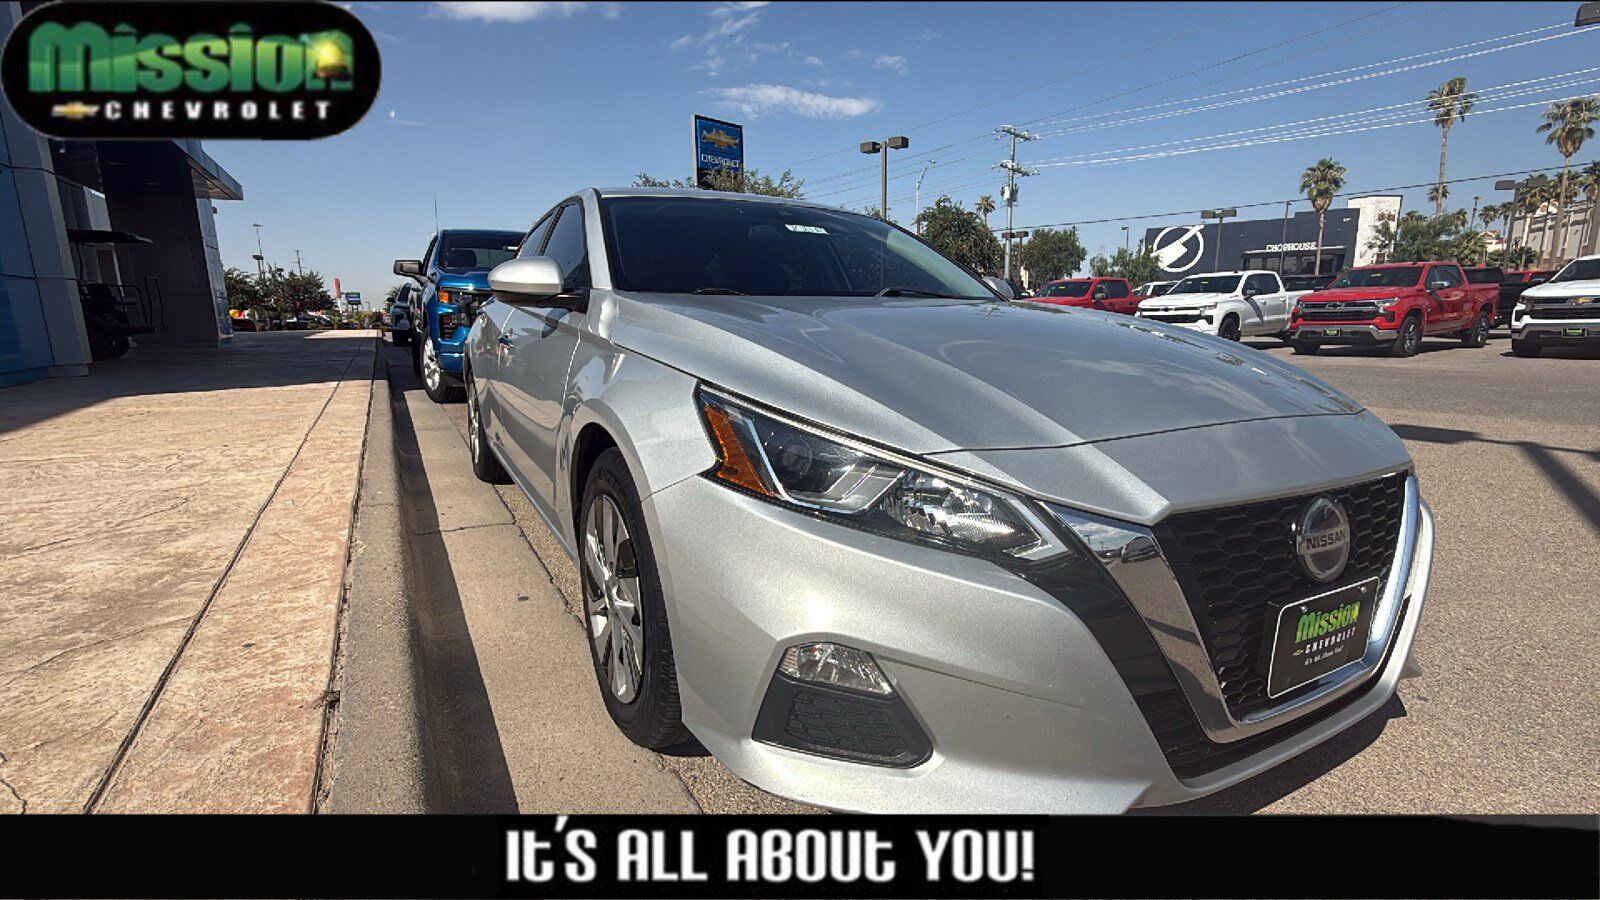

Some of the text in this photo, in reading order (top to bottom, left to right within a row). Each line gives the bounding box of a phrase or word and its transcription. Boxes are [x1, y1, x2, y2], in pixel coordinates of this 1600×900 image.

[1266, 241, 1317, 253] CHOPHOUSE
[1306, 529, 1346, 551] NISSAN
[1294, 601, 1361, 644] Mission
[1305, 626, 1356, 654] CHEVROLET
